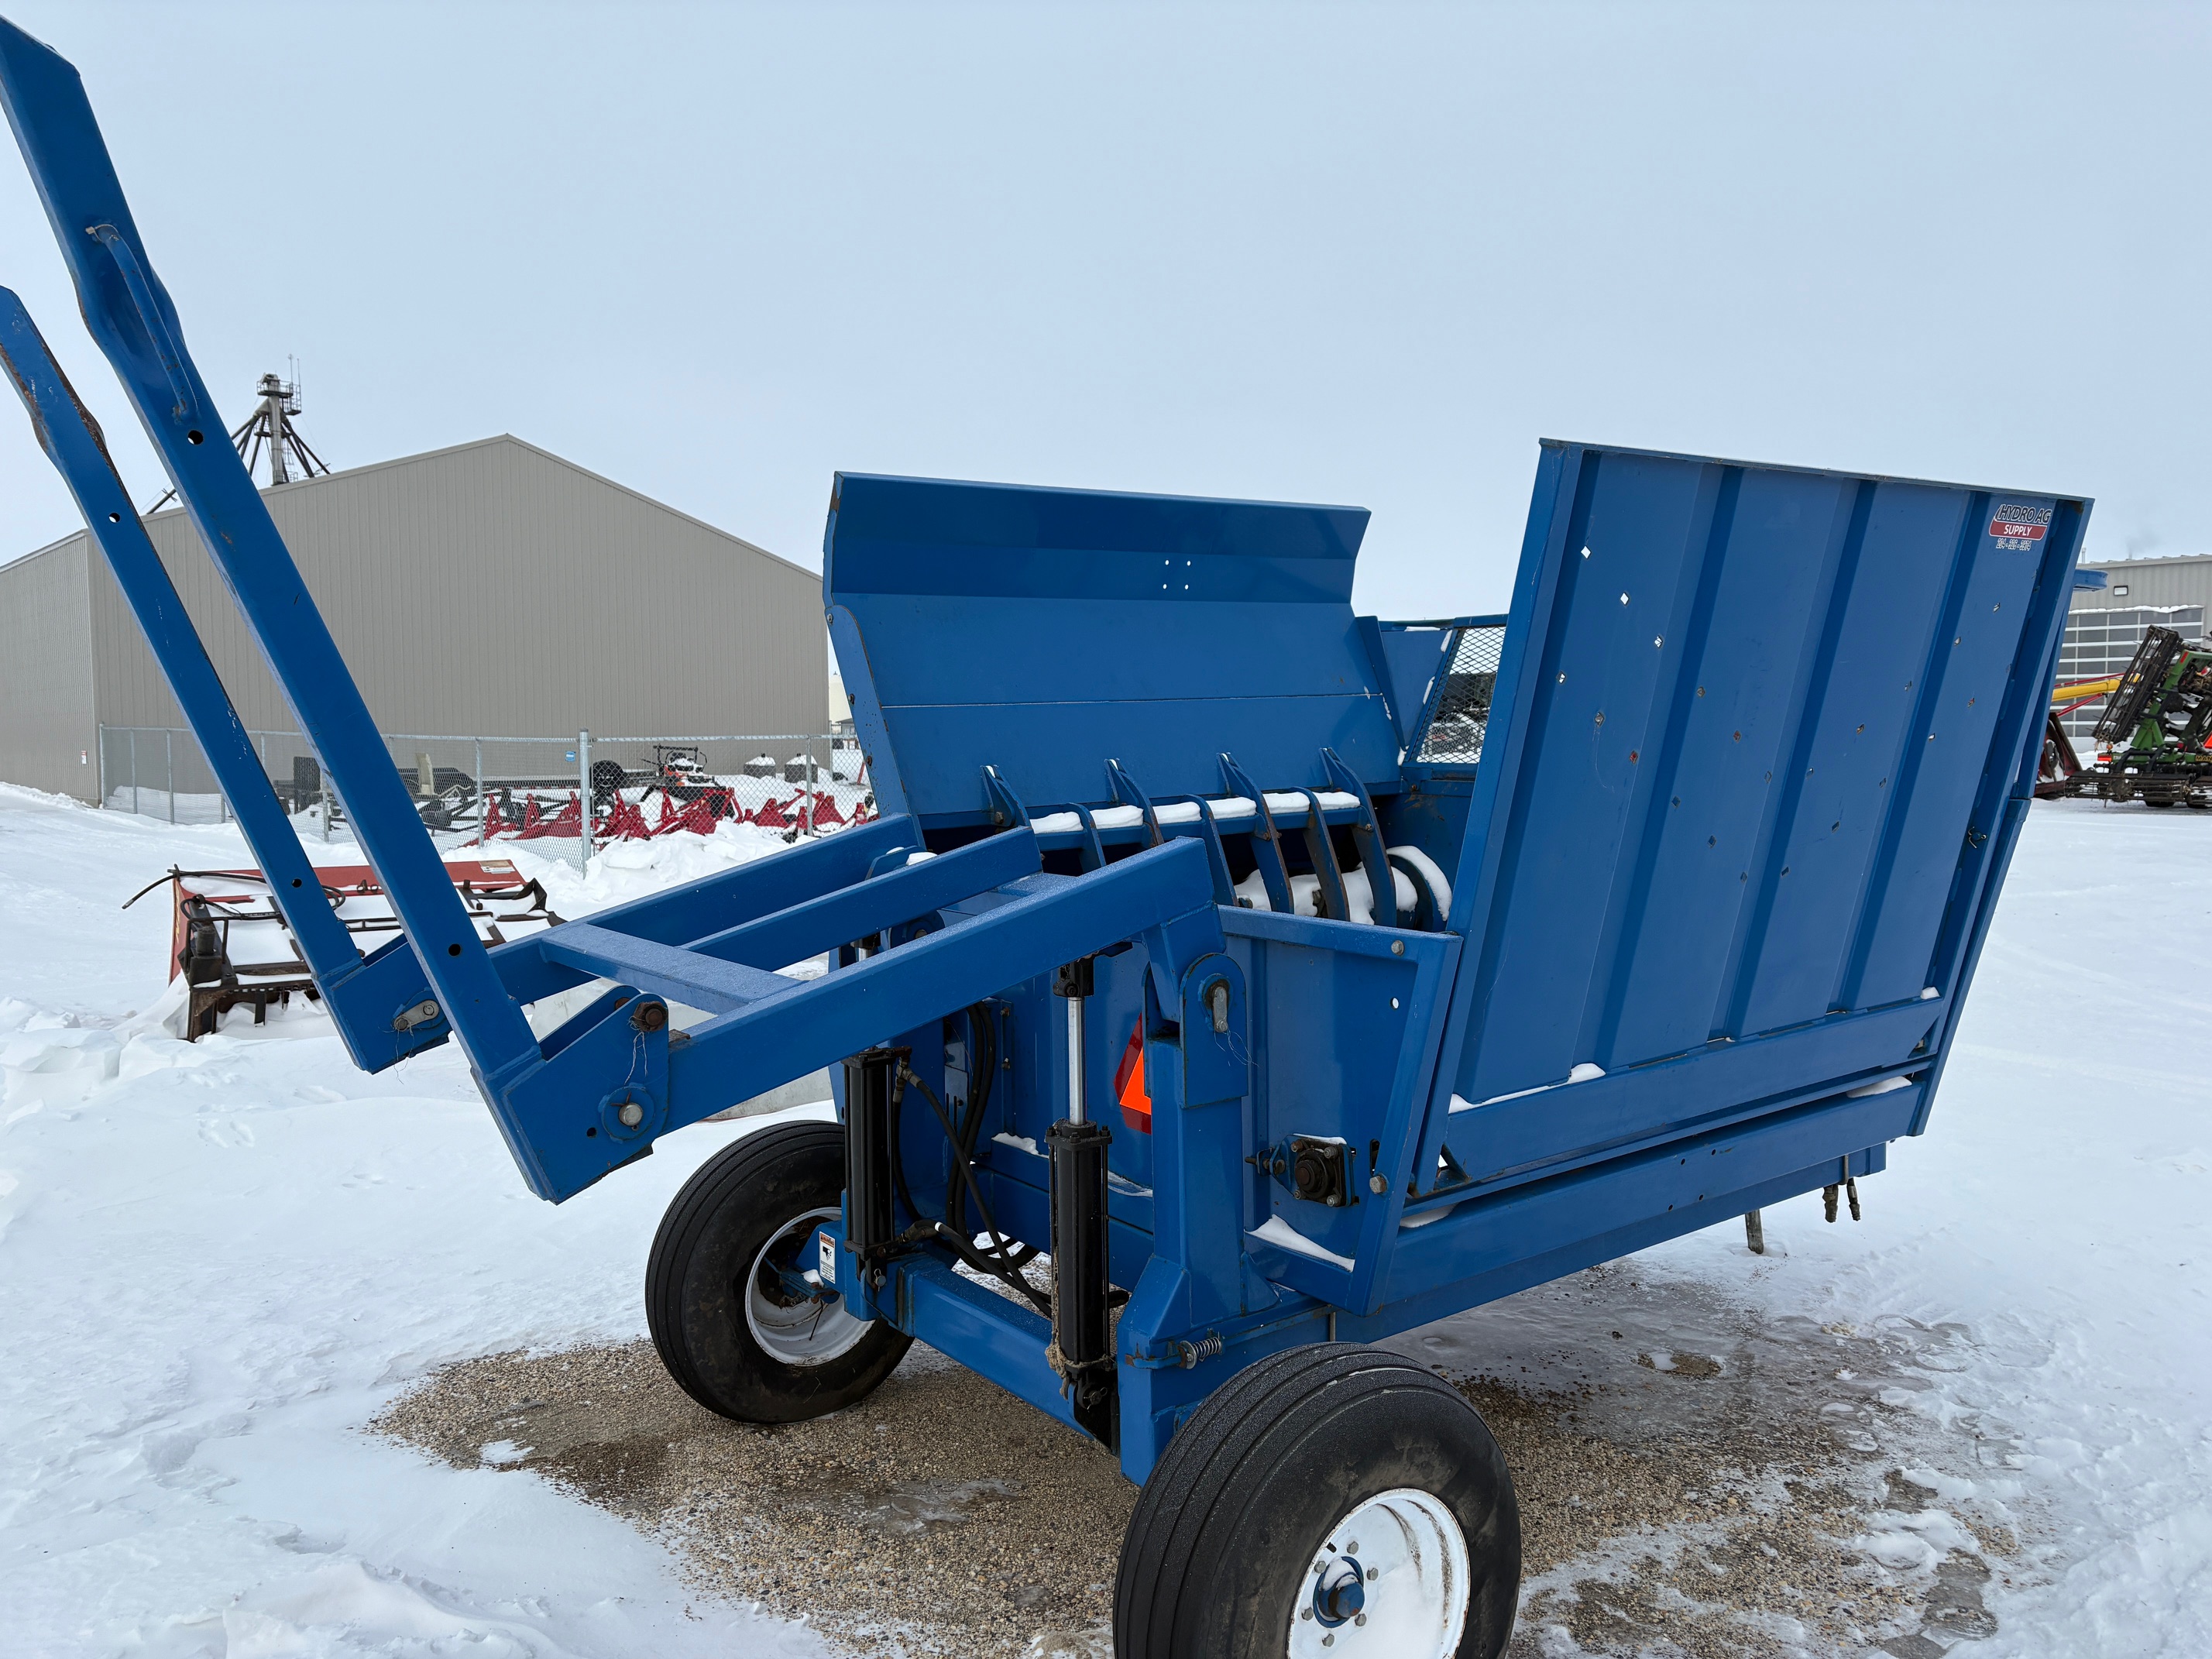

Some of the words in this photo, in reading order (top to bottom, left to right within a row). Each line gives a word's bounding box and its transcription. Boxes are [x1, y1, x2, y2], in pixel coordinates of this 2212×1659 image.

[1997, 504, 2035, 522] HYDRO
[2035, 509, 2052, 524] AG
[2004, 525, 2032, 536] SUPPLY
